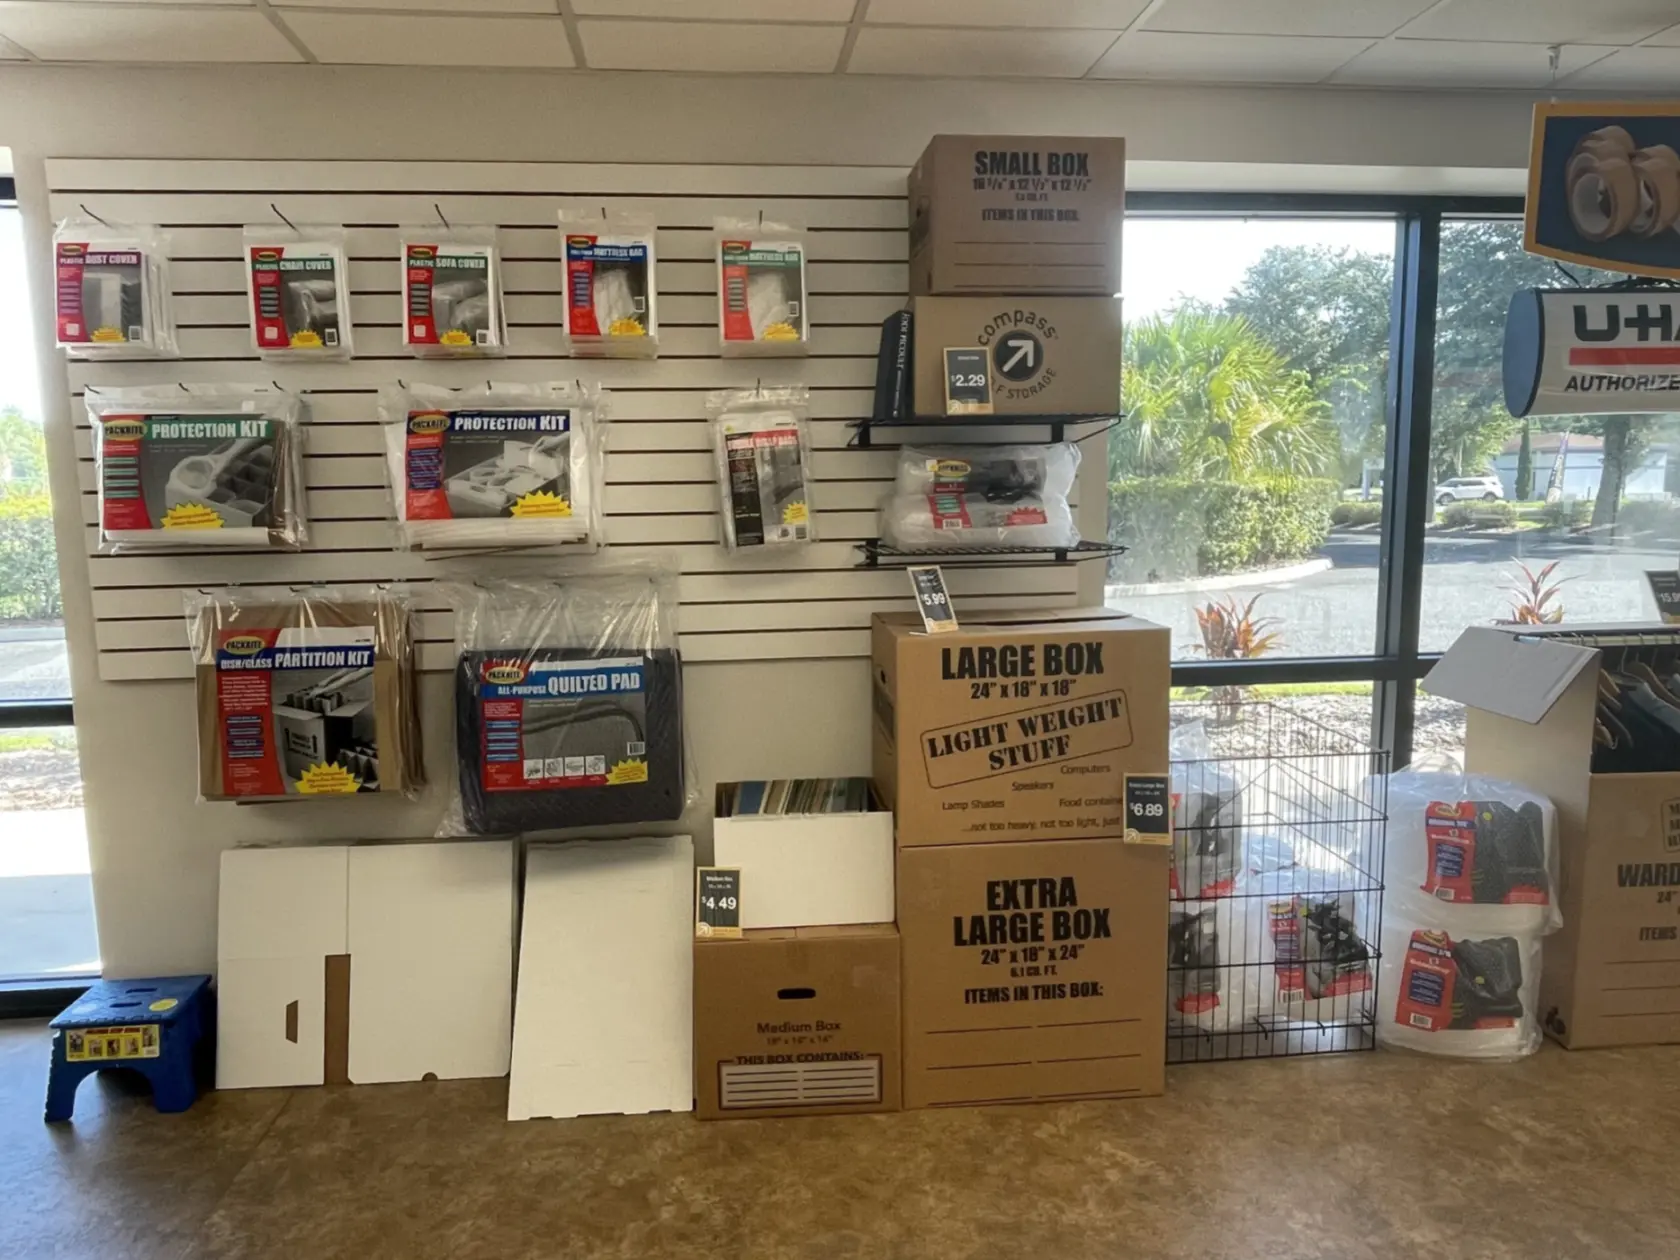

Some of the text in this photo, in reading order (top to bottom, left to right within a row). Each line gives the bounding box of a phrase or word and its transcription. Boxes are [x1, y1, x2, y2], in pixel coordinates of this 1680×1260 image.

[974, 150, 1089, 177] SMALL BOX
[981, 208, 1015, 221] ITEMS
[1016, 208, 1027, 221] IN
[1030, 208, 1055, 221] THIS
[109, 254, 138, 264] COVER
[305, 260, 332, 270] COVER
[435, 258, 457, 268] SOFA
[457, 259, 486, 268] COVER
[977, 309, 1056, 346] compass
[1572, 304, 1680, 341] U-H
[951, 374, 986, 387] $2.29
[1006, 367, 1056, 399] STORAGE
[151, 422, 236, 439] PROTECTION
[239, 420, 268, 438] KIT
[454, 417, 537, 431] PROTECTION
[540, 415, 566, 431] KIT
[920, 592, 946, 605] $5.99
[220, 650, 371, 669] DISH/GLASS PARTITION KIT
[942, 641, 1104, 680] LARGE BOX
[548, 674, 607, 696] QUILTED
[611, 672, 640, 690] PAD
[970, 682, 997, 699] 24"
[1000, 684, 1009, 698] x
[1039, 683, 1048, 697] x
[1052, 679, 1076, 696] 18"
[928, 697, 1122, 758] LIGHT WEIGHT
[988, 734, 1071, 771] STUFF
[1060, 763, 1111, 775] Computers
[1011, 781, 1055, 791] Speakers
[942, 795, 1123, 811] Lamp Shades Food containe
[1129, 802, 1164, 817] $6.89
[989, 822, 1005, 831] too
[1040, 820, 1056, 829] not
[1058, 819, 1074, 828] too
[986, 876, 1078, 911] EXTRA
[1656, 891, 1679, 904] 24"
[701, 895, 737, 910] $4.49
[953, 907, 1112, 946] LARGE BOX
[1639, 926, 1677, 941] ITEMS
[981, 948, 1006, 965] 24"
[1048, 948, 1056, 961] x
[1060, 944, 1085, 960] 24"
[964, 981, 1104, 1004] ITEMS IN THIS BOX:
[756, 1020, 841, 1034] Medium Box
[736, 1051, 865, 1066] THIS BOX CONTAINS:
